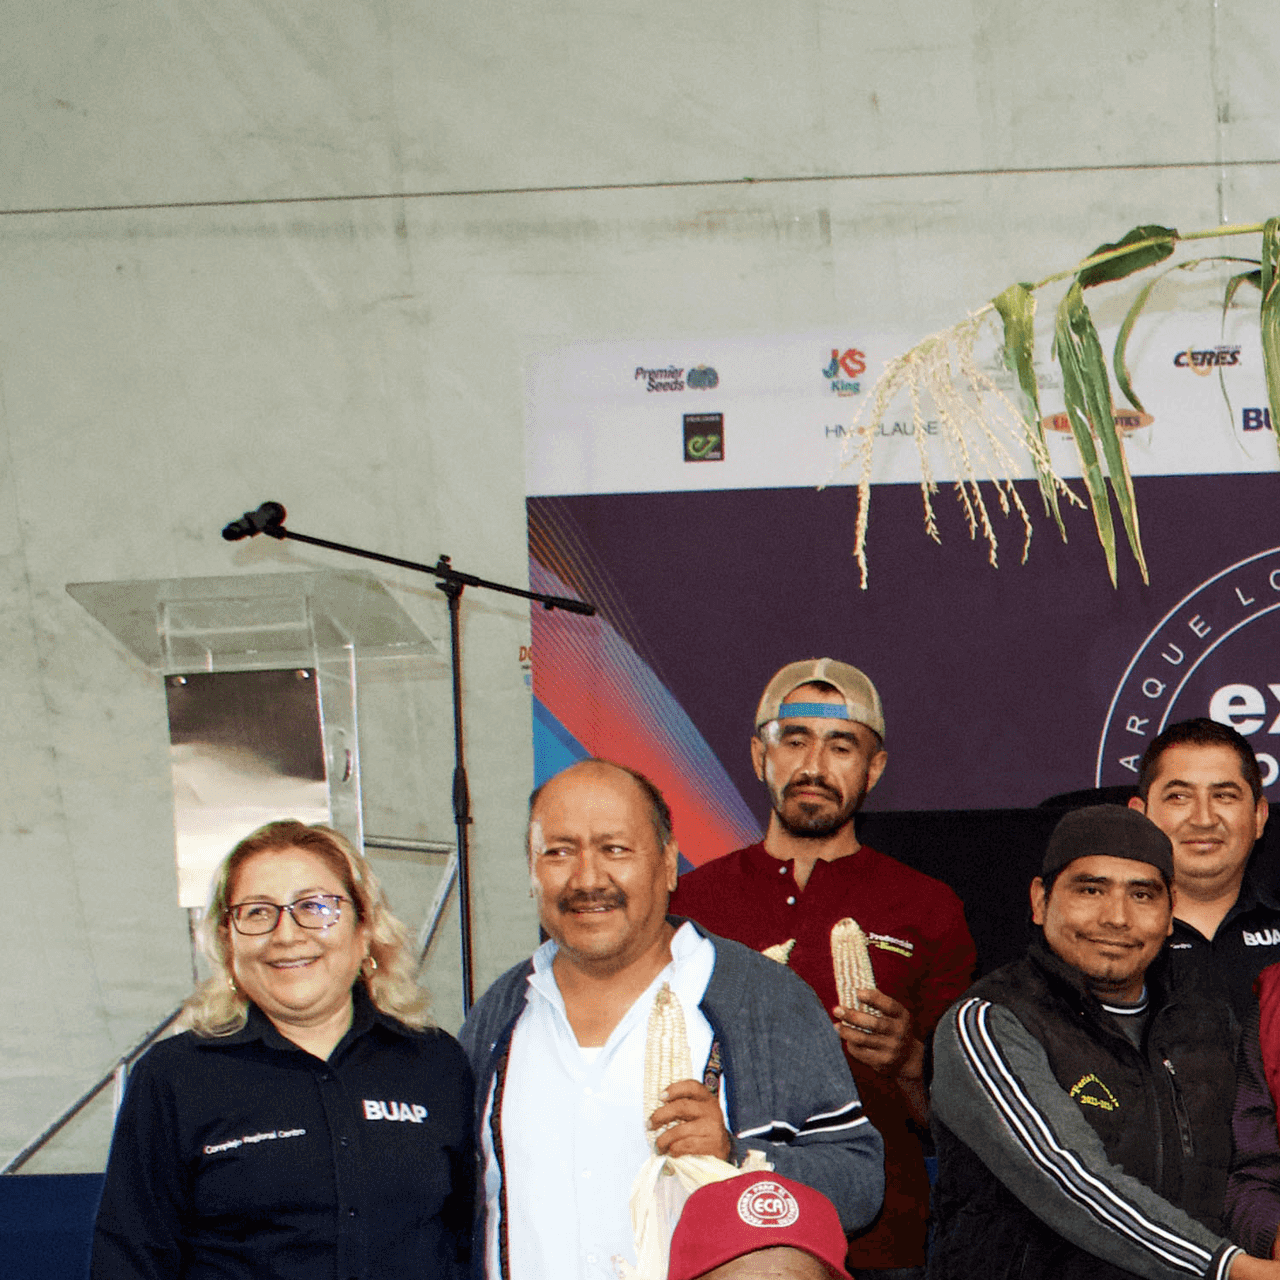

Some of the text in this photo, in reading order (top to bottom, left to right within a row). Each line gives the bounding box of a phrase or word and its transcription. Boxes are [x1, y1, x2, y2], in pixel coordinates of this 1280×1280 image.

[1174, 350, 1240, 367] CERES
[634, 365, 684, 381] Premier
[646, 379, 684, 392] Seeds
[362, 1100, 428, 1123] BUAP
[754, 1198, 783, 1214] ECA
